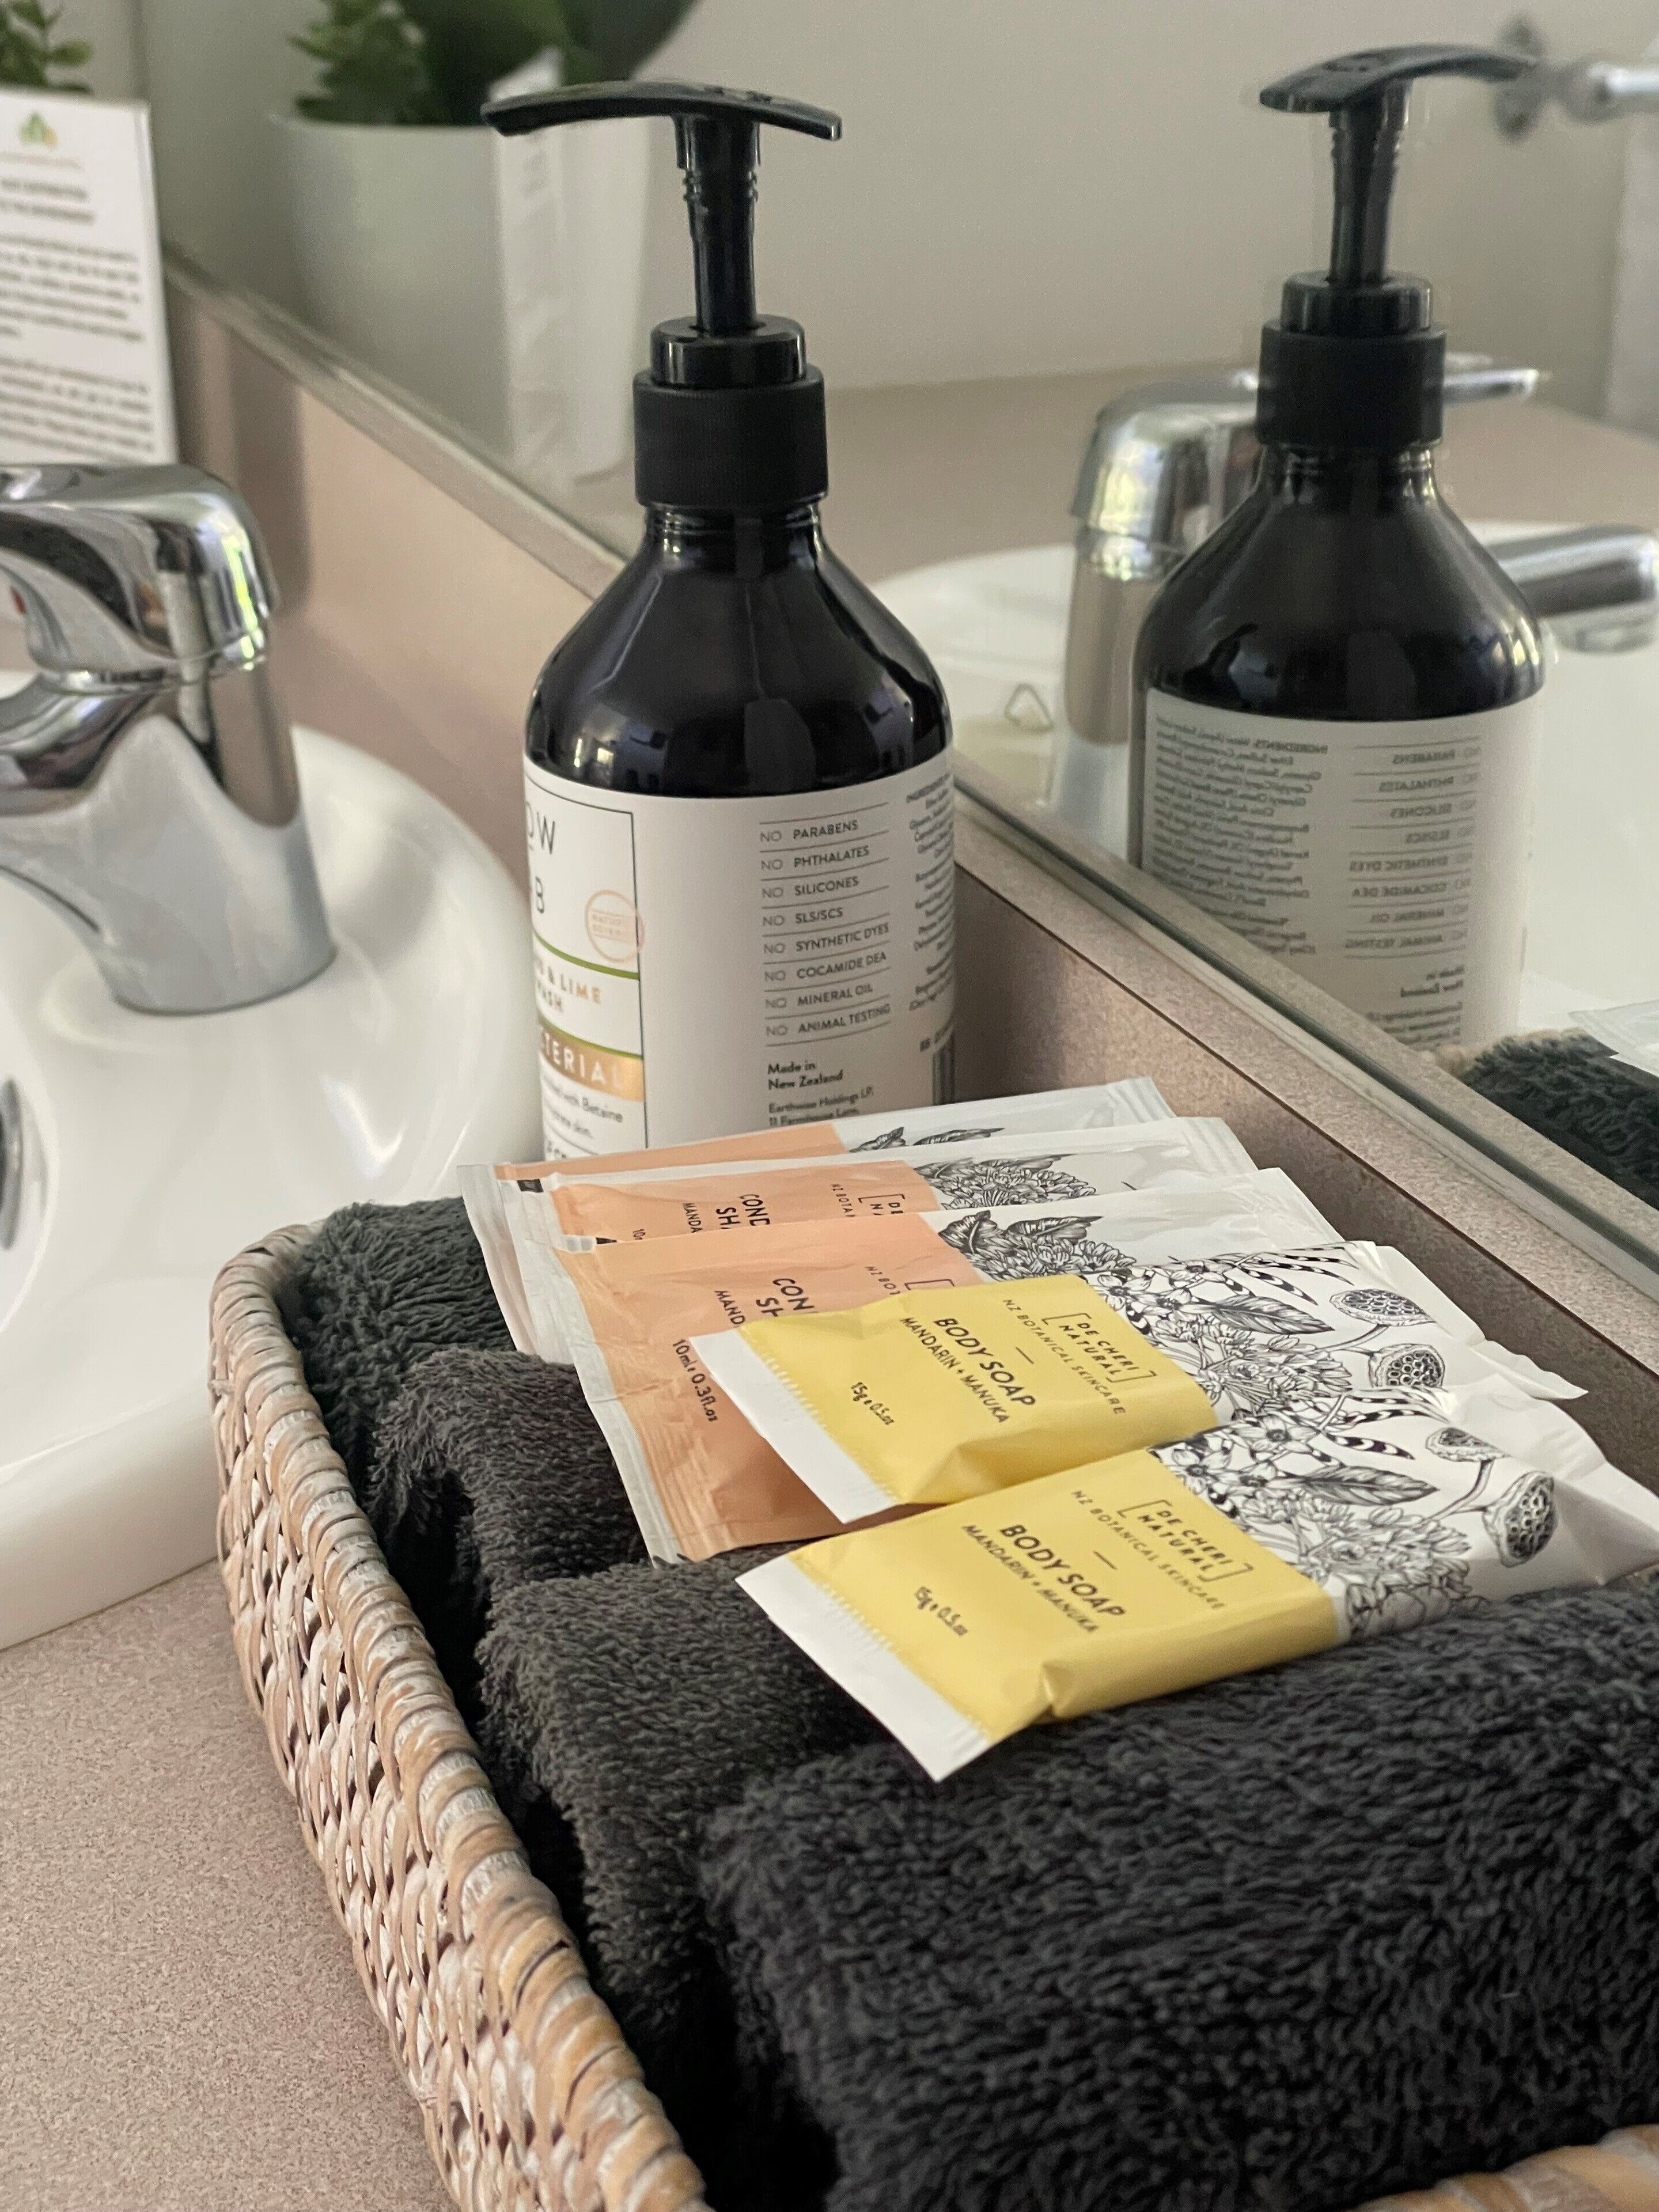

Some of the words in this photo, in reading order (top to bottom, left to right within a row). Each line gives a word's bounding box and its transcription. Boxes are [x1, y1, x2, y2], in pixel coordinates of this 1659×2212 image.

[760, 830, 782, 842] NO
[793, 820, 858, 839] PARABENS
[761, 859, 783, 870] NO
[794, 845, 870, 868] PHTHALATES
[762, 887, 783, 898] NO
[794, 876, 858, 896] SILICONES
[763, 915, 785, 926] NO
[764, 942, 786, 954] NO
[796, 930, 861, 952] SYNTHETIC
[863, 922, 889, 940] DYES
[764, 970, 786, 981] NO
[797, 957, 863, 979] COCAMIDE
[866, 952, 886, 965] DEA
[560, 973, 601, 1004] LIME
[766, 997, 787, 1009] NO
[797, 988, 853, 1006] MINERAL
[855, 983, 873, 995] OIL
[766, 1025, 787, 1036] NO
[798, 1017, 847, 1034] ANIMAL
[849, 1003, 891, 1024] TESTING
[540, 1027, 622, 1090] TERIAL
[768, 1061, 801, 1075] Made
[805, 1060, 817, 1070] in
[768, 1078, 795, 1090] New
[799, 1069, 843, 1088] Zealand
[715, 1207, 741, 1230] SH
[836, 1194, 856, 1217] BOTA
[870, 1203, 884, 1215] N
[772, 1278, 819, 1313] CON
[673, 1339, 698, 1368] 10ml
[1003, 1299, 1022, 1312] NZ
[1017, 1315, 1073, 1363] BOTANICAL
[1071, 1365, 1126, 1415] SKINCARE
[1059, 1325, 1122, 1375] NATURAL
[1077, 1322, 1100, 1335] DE
[1097, 1340, 1139, 1370] CHERI
[900, 1317, 961, 1370] MANDARIN
[960, 1374, 1010, 1423] MANUKA
[933, 1318, 994, 1357] BODY
[979, 1361, 1036, 1406] SOAP
[1137, 1514, 1214, 1571] NATURAL
[1157, 1510, 1183, 1525] DE
[1182, 1529, 1233, 1565] CHERI
[961, 1525, 1035, 1580] MANDARIN
[1037, 1588, 1099, 1633] MANUKA
[999, 1524, 1070, 1570] BODY
[1056, 1573, 1126, 1615] SOAP
